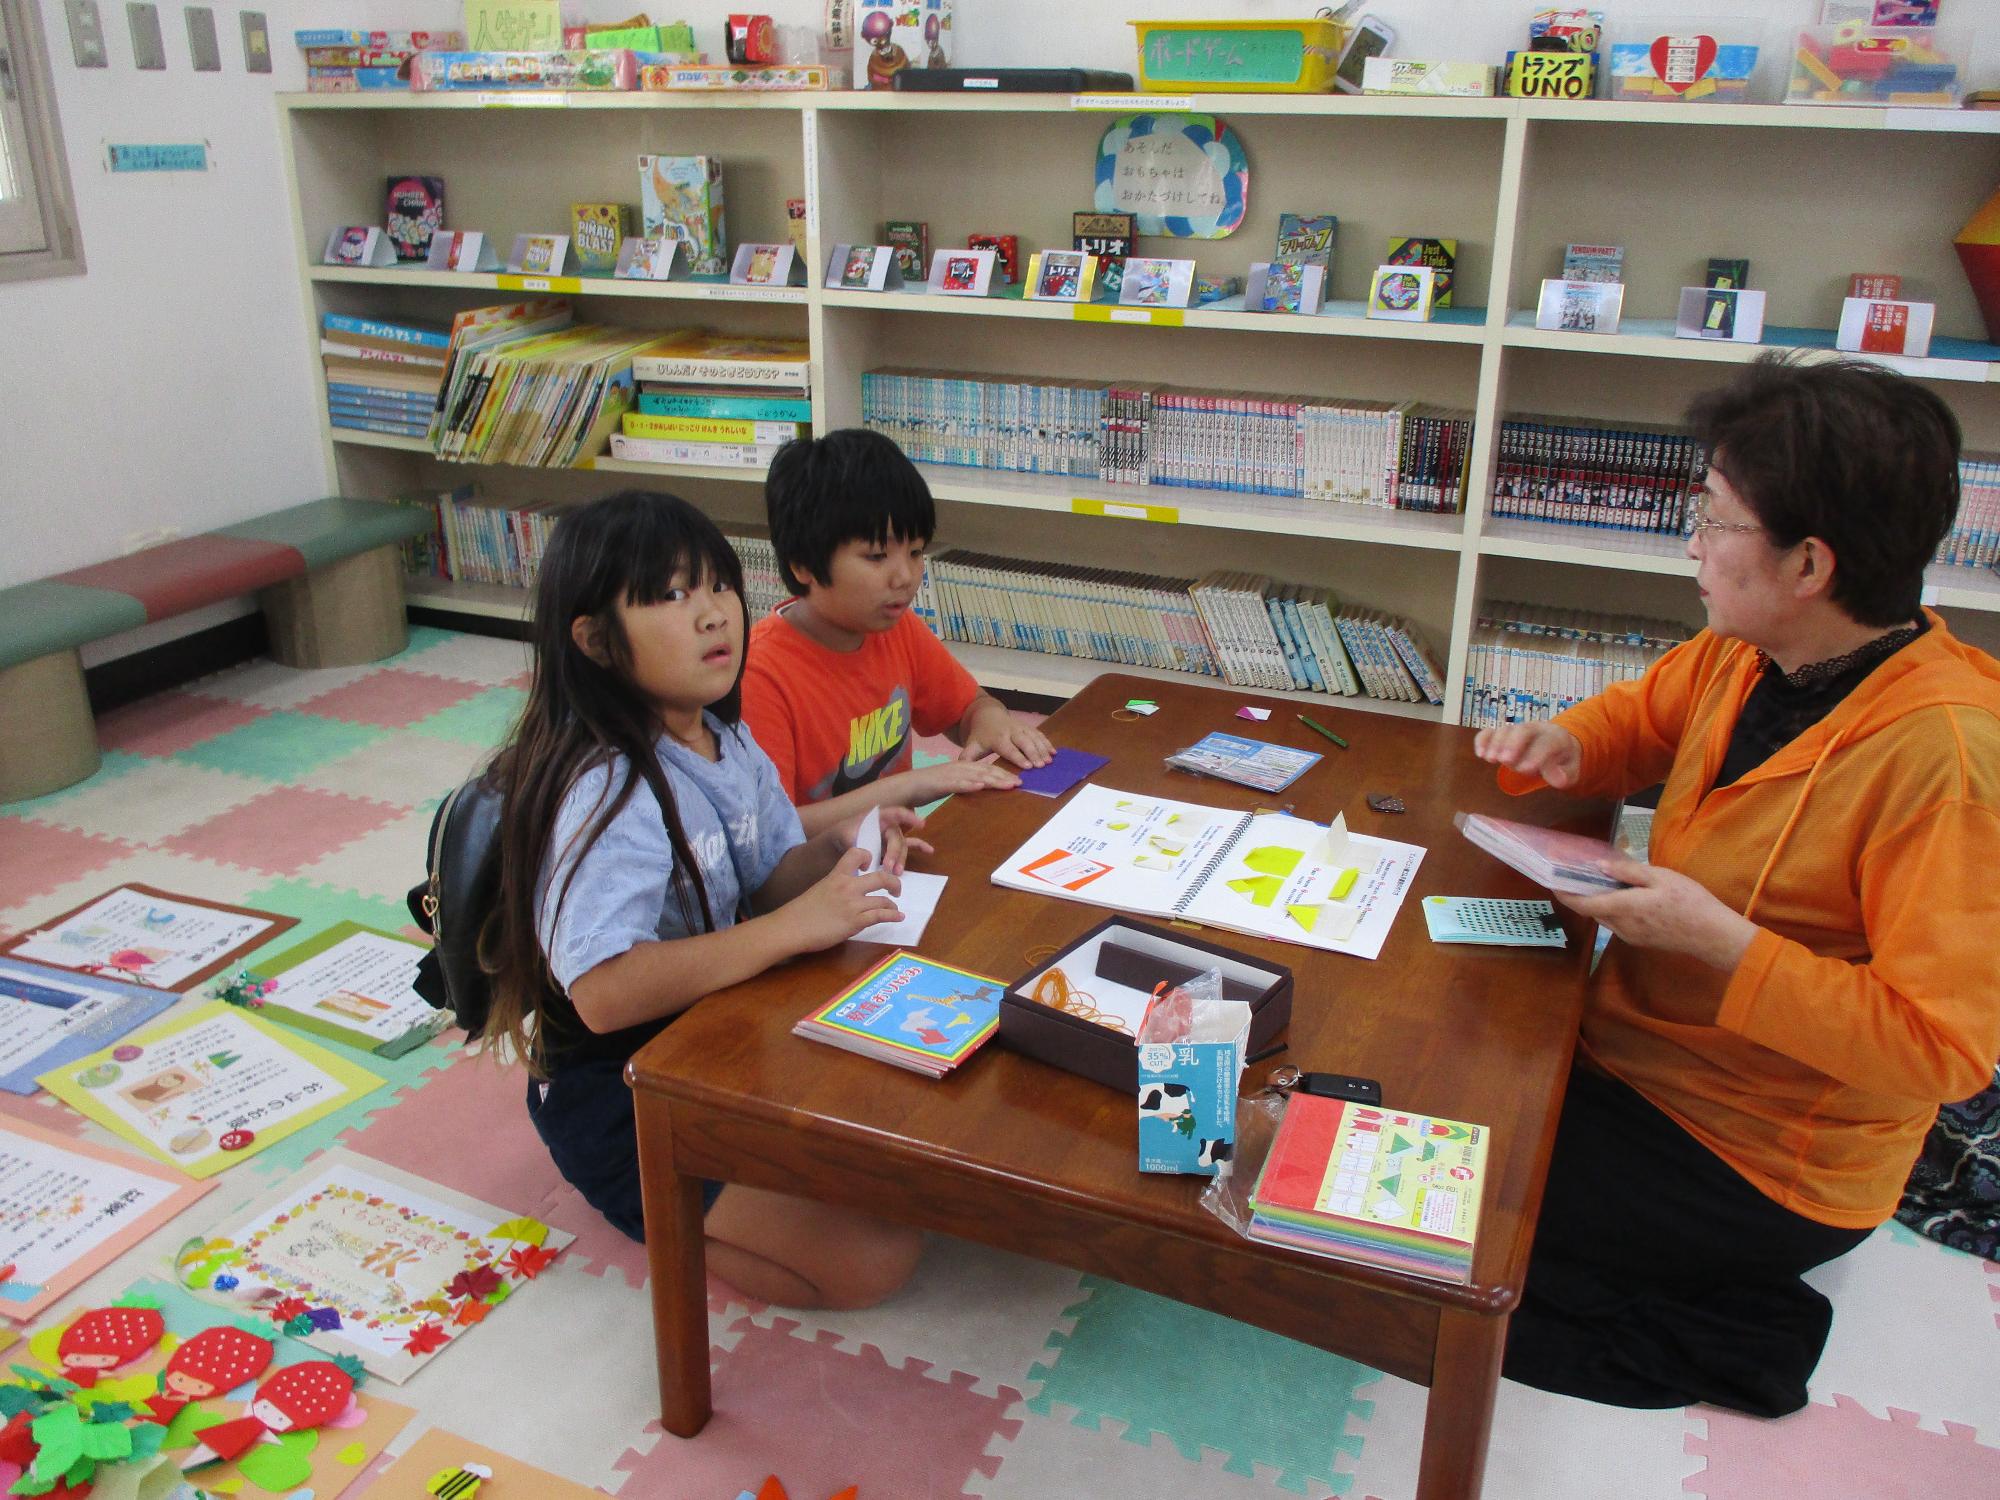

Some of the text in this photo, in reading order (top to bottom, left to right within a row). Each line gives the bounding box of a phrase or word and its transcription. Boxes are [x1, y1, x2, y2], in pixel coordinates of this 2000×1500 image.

[1151, 37, 1244, 69] ボードゲーム
[1522, 55, 1584, 77] トランプ
[1521, 77, 1584, 98] UNO
[1124, 141, 1174, 154] あそんだ
[1123, 165, 1185, 179] おもちゃは
[578, 236, 614, 253] BLAST
[1081, 239, 1124, 255] トリオ
[1049, 266, 1077, 276] トリオ
[847, 699, 903, 767] NIKE
[1146, 1052, 1169, 1060] 35%
[1179, 1047, 1199, 1066] 乳
[1145, 1163, 1178, 1172] 1000ml
